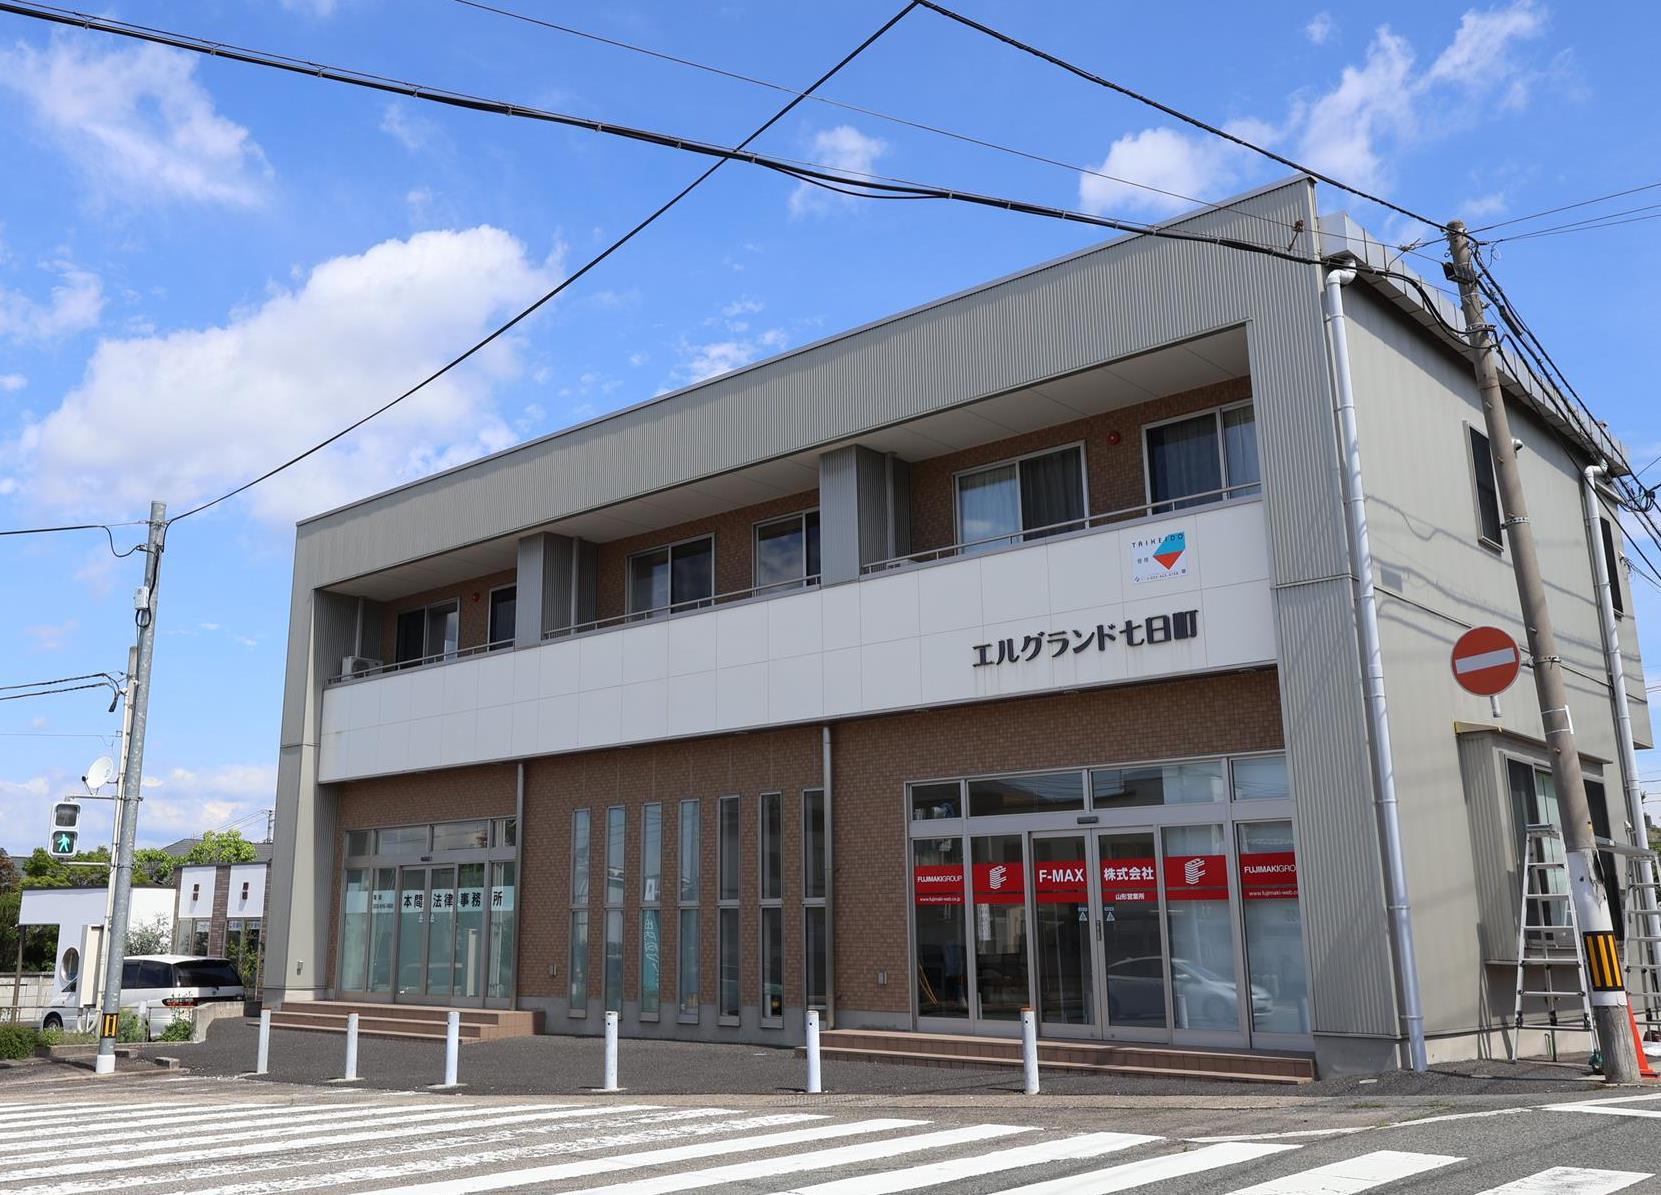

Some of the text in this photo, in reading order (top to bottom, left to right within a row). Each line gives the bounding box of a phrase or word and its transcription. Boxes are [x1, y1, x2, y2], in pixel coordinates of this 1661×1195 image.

[972, 609, 1199, 667] エルグランド七日町
[917, 874, 963, 884] FUJIMAKIGROUP
[1039, 866, 1155, 883] F-MAX 株式会社
